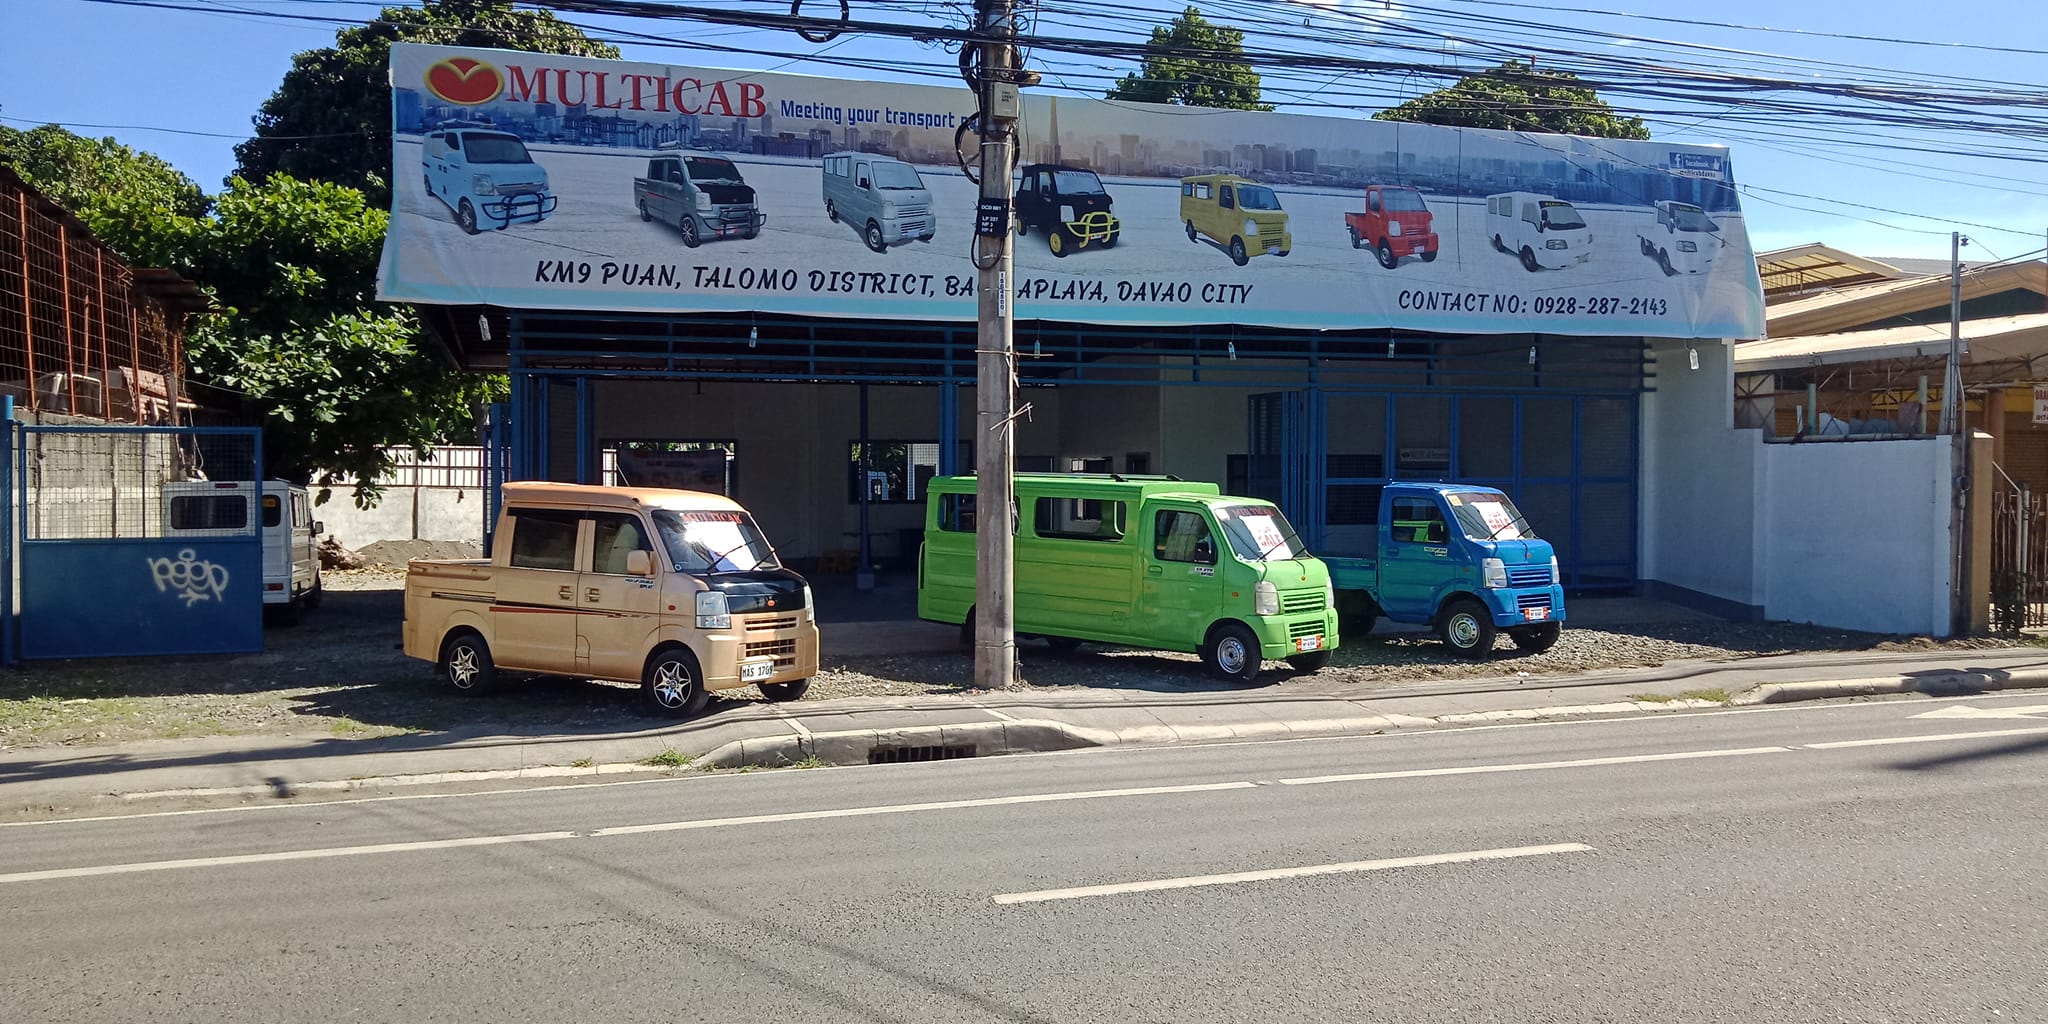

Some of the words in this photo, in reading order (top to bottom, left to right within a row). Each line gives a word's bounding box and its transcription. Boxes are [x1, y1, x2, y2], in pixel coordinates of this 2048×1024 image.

[505, 64, 767, 118] MULTICAB
[780, 99, 842, 125] Meeting
[847, 107, 880, 126] your
[885, 106, 955, 130] transport
[535, 260, 592, 284] KM9
[601, 262, 682, 290] PUAN,
[692, 265, 799, 291] TALOMO
[808, 270, 936, 298] DISTRICT,
[1016, 278, 1109, 303] APLAYA,
[1117, 280, 1192, 303] DAVAO
[1201, 283, 1254, 304] CITY
[1398, 289, 1490, 313] CONTACT
[1493, 293, 1528, 315] NO:
[1533, 296, 1668, 317] 0928-287-2143
